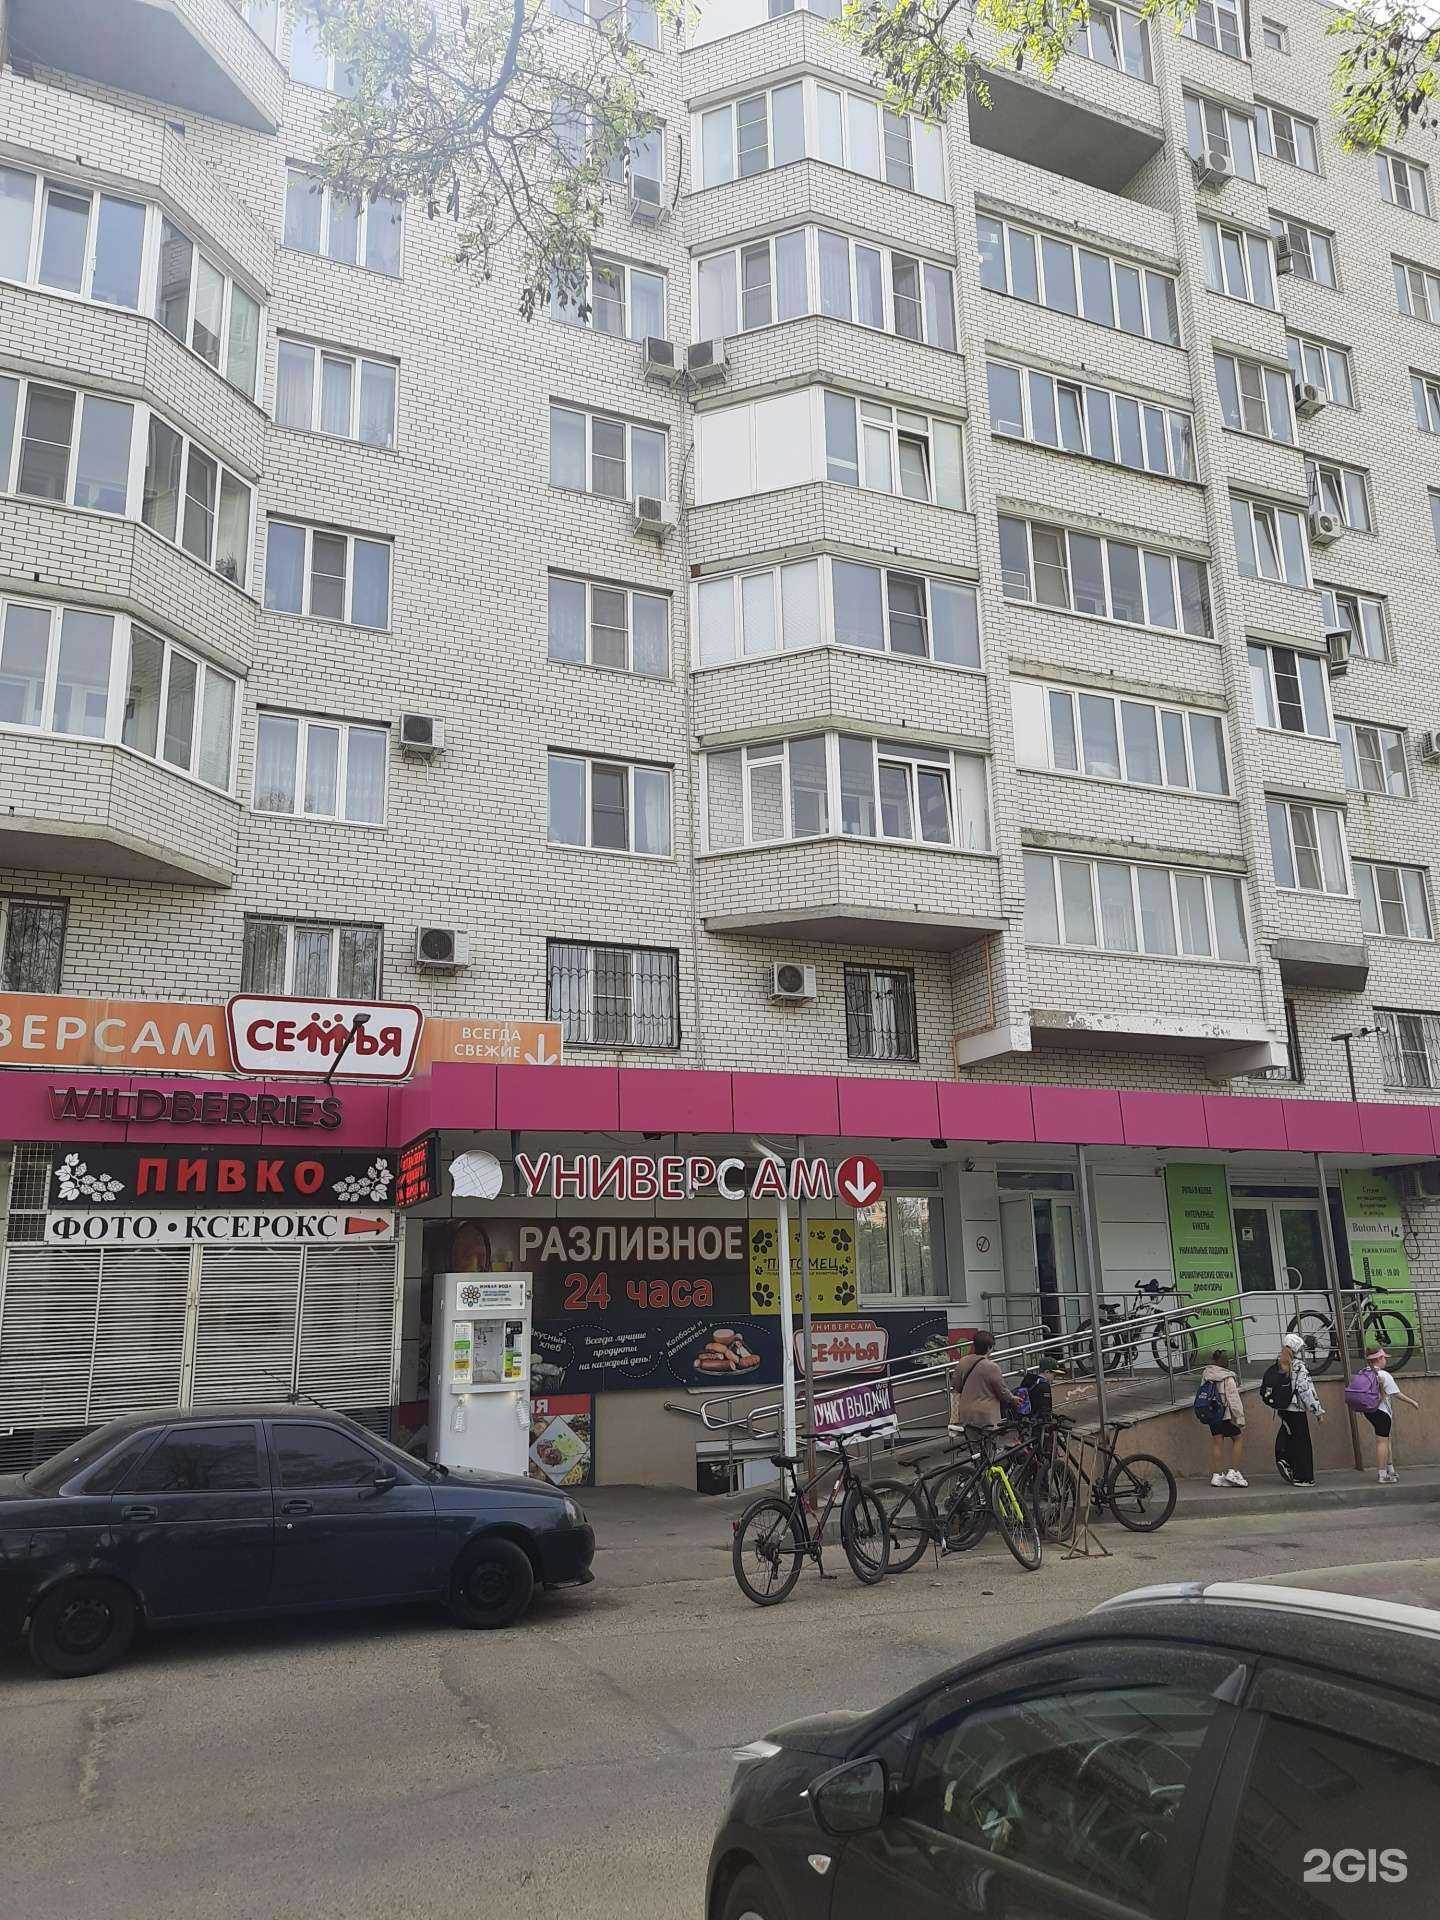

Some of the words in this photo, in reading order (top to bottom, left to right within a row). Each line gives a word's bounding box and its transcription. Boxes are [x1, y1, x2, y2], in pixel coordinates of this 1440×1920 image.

[462, 1027, 521, 1042] ВСЕГДА
[454, 1043, 520, 1058] СВЕЖИЕ
[48, 1086, 342, 1129] WILDBERRIES
[136, 1157, 325, 1196] ПИВКО
[515, 1152, 832, 1200] УНИВЕРСАМ
[52, 1216, 158, 1239] ФОТО
[184, 1215, 337, 1238] КСЕРОКС
[519, 1225, 744, 1262] РАЗЛИВНОЕ
[564, 1271, 611, 1310] 24
[626, 1278, 713, 1309] часа
[539, 1340, 562, 1352] хлеб
[584, 1336, 614, 1346] Всегда
[615, 1332, 647, 1344] лучшие
[666, 1324, 697, 1348] Колбасы
[578, 1363, 590, 1371] на
[591, 1359, 629, 1369] каждый
[630, 1355, 651, 1368] день!
[593, 1345, 638, 1357] продукты
[846, 1388, 891, 1419] ВЫДАЧИ
